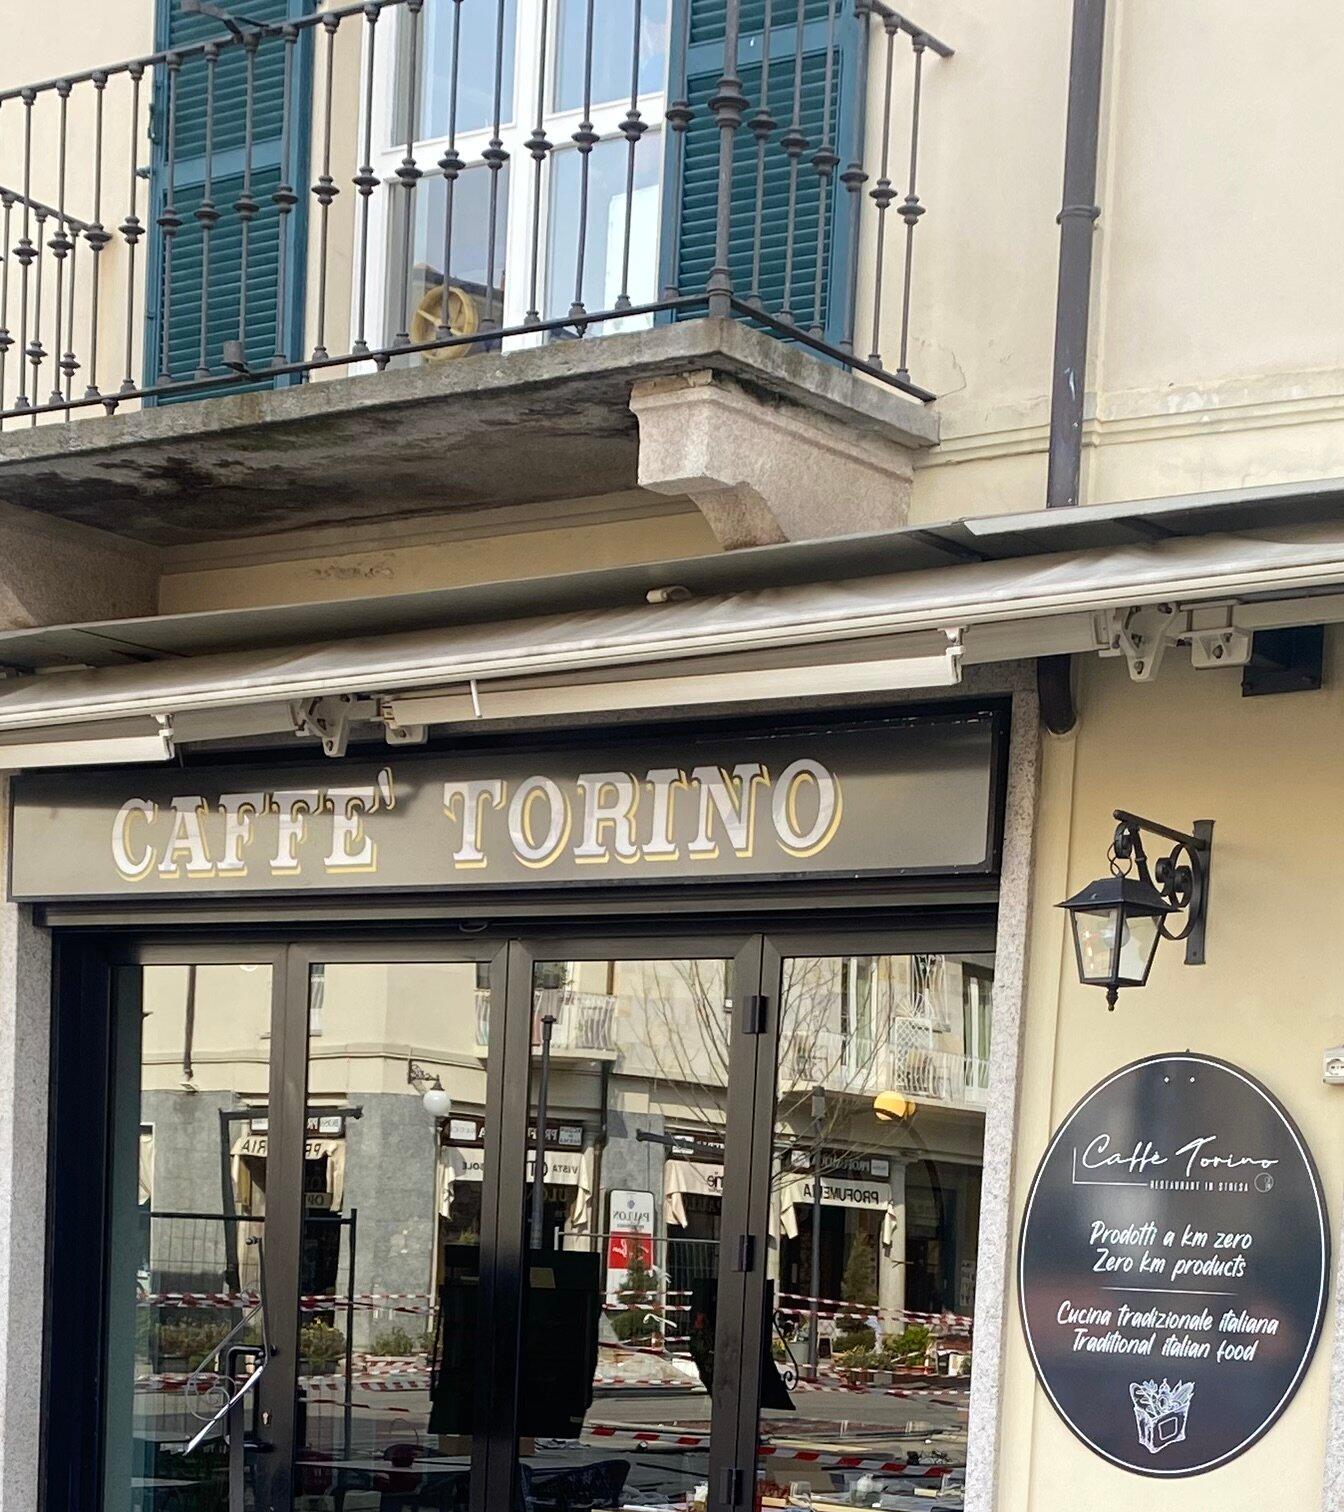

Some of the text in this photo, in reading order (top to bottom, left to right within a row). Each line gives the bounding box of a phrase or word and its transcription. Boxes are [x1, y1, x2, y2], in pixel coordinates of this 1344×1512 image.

[443, 757, 844, 870] TORINO
[1175, 1135, 1279, 1177] Torino
[1089, 1220, 1253, 1250] Prodotti a km zero
[1093, 1248, 1247, 1281] Zero km products
[1057, 1300, 1280, 1336] Cucina tradizionale italiana
[1072, 1328, 1260, 1363] Traditional italian food
